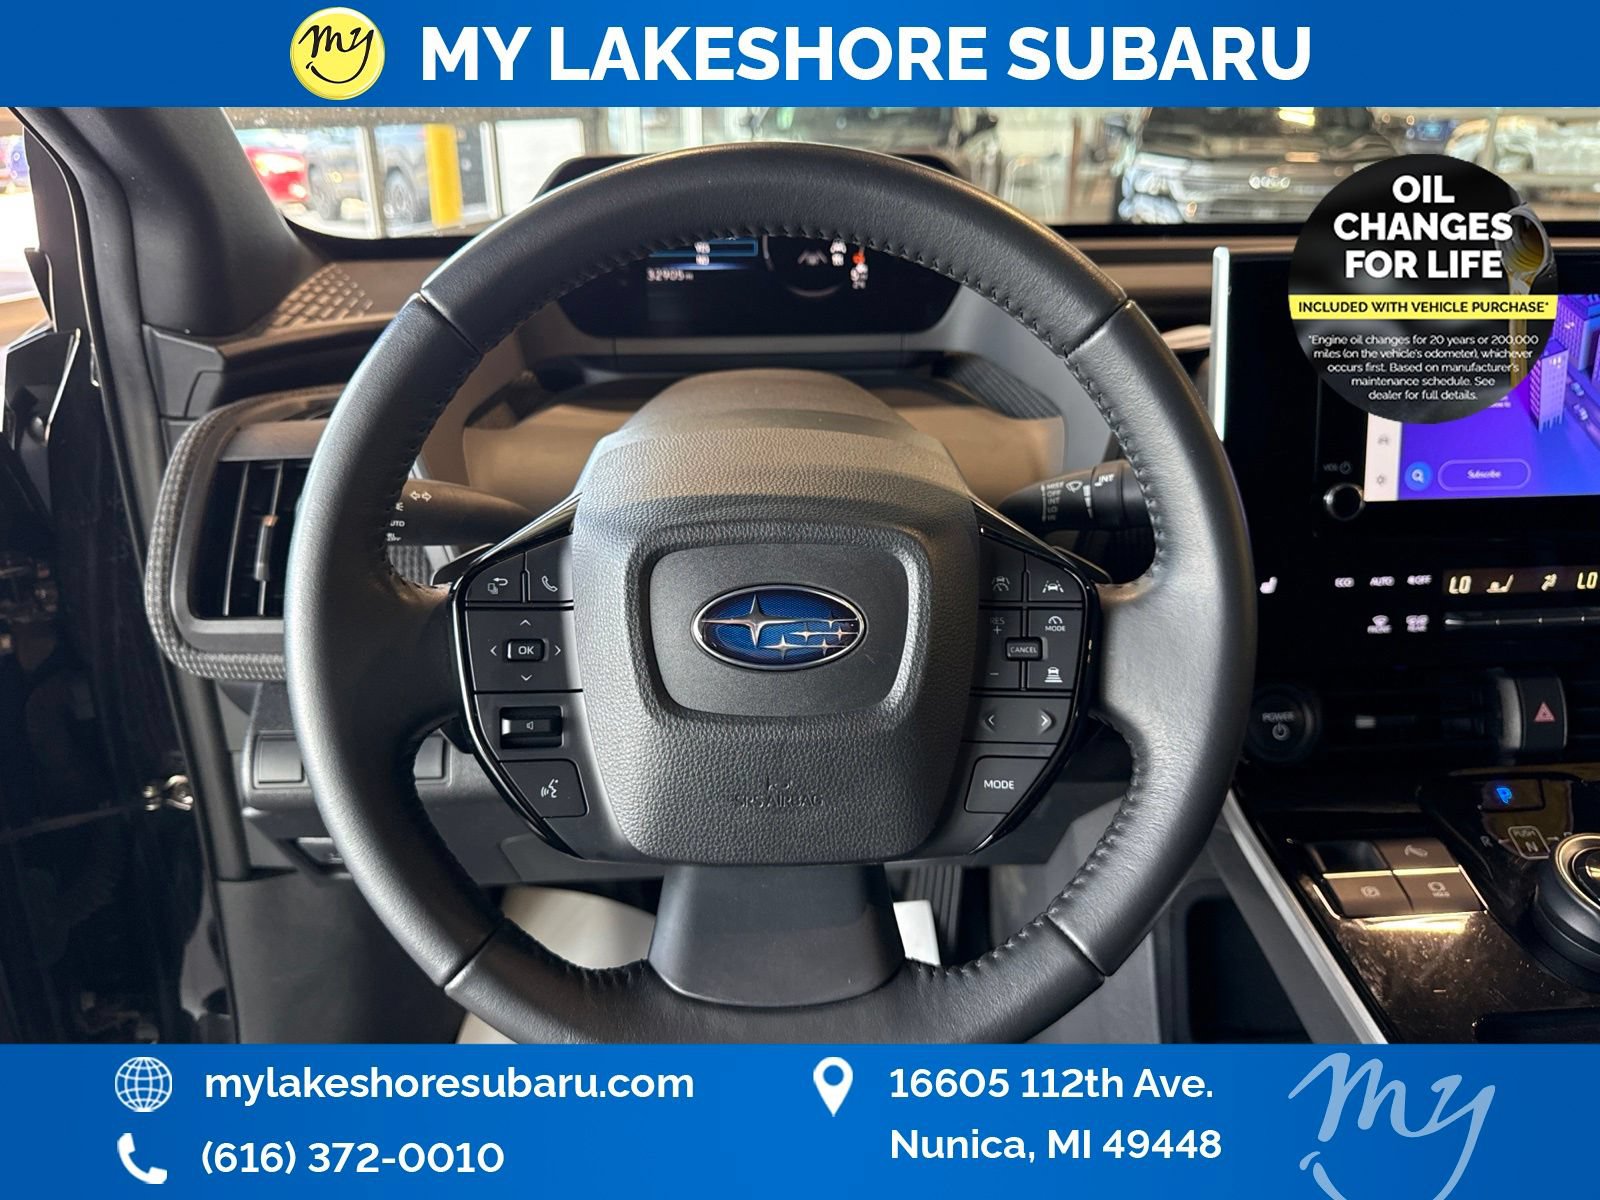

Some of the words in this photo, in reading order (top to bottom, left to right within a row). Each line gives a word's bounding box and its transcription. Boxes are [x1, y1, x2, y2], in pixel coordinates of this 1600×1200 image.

[1369, 575, 1395, 587] AUTO
[1448, 575, 1472, 595] LO
[1576, 571, 1599, 590] LO
[517, 645, 535, 655] OK
[1009, 646, 1038, 654] CANCEL
[983, 779, 1015, 790] MODE
[1496, 787, 1513, 804] P
